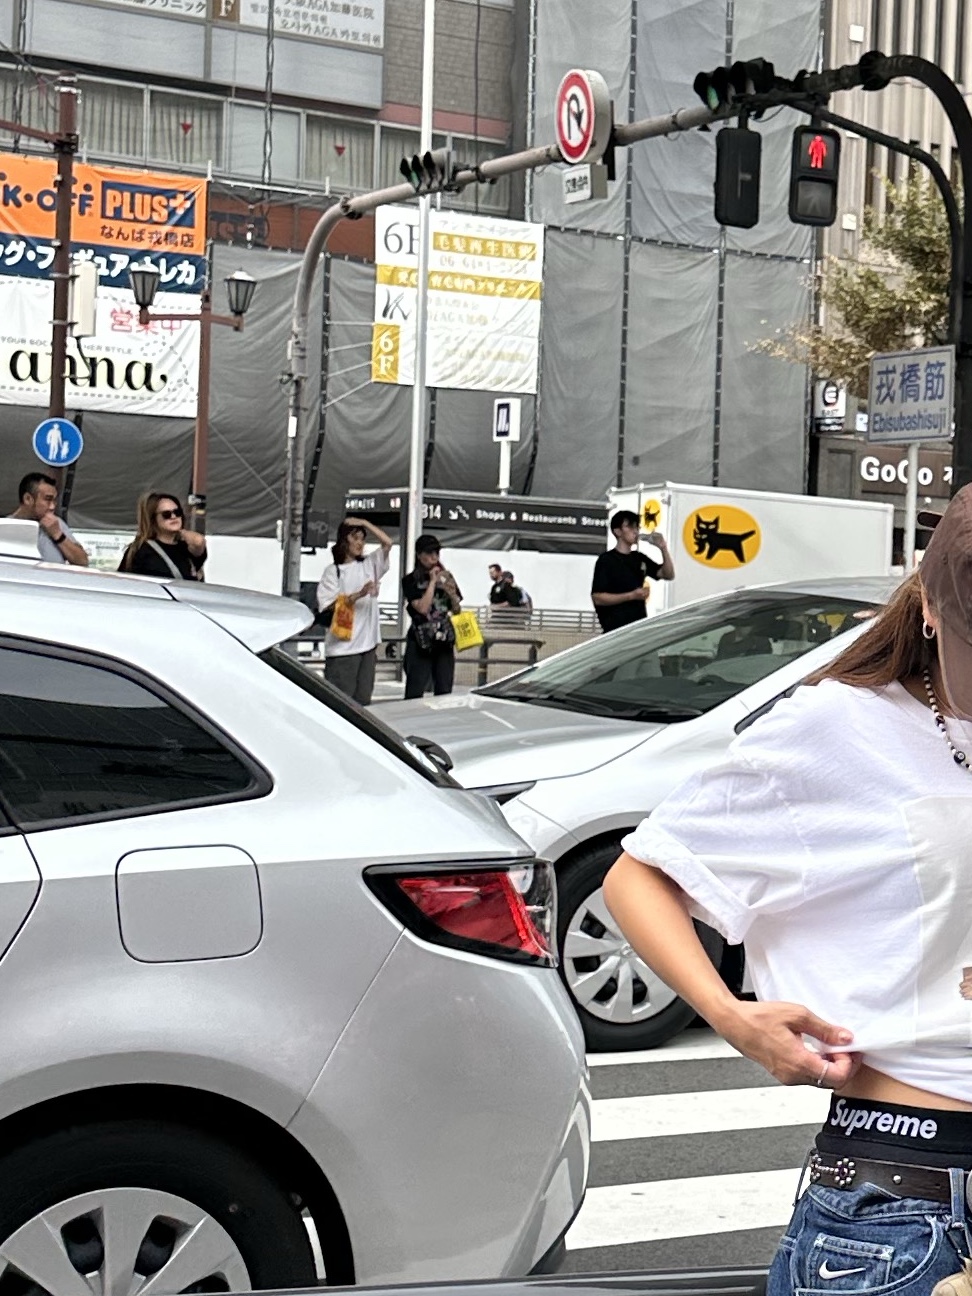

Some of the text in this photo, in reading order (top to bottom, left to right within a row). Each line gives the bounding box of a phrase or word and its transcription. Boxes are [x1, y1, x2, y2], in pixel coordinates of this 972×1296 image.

[875, 360, 946, 405] 戎橋筋
[872, 407, 947, 435] Ebisubashisuji
[475, 508, 506, 521] Shops
[521, 511, 577, 526] Restaurants
[830, 1098, 938, 1140] Supreme
